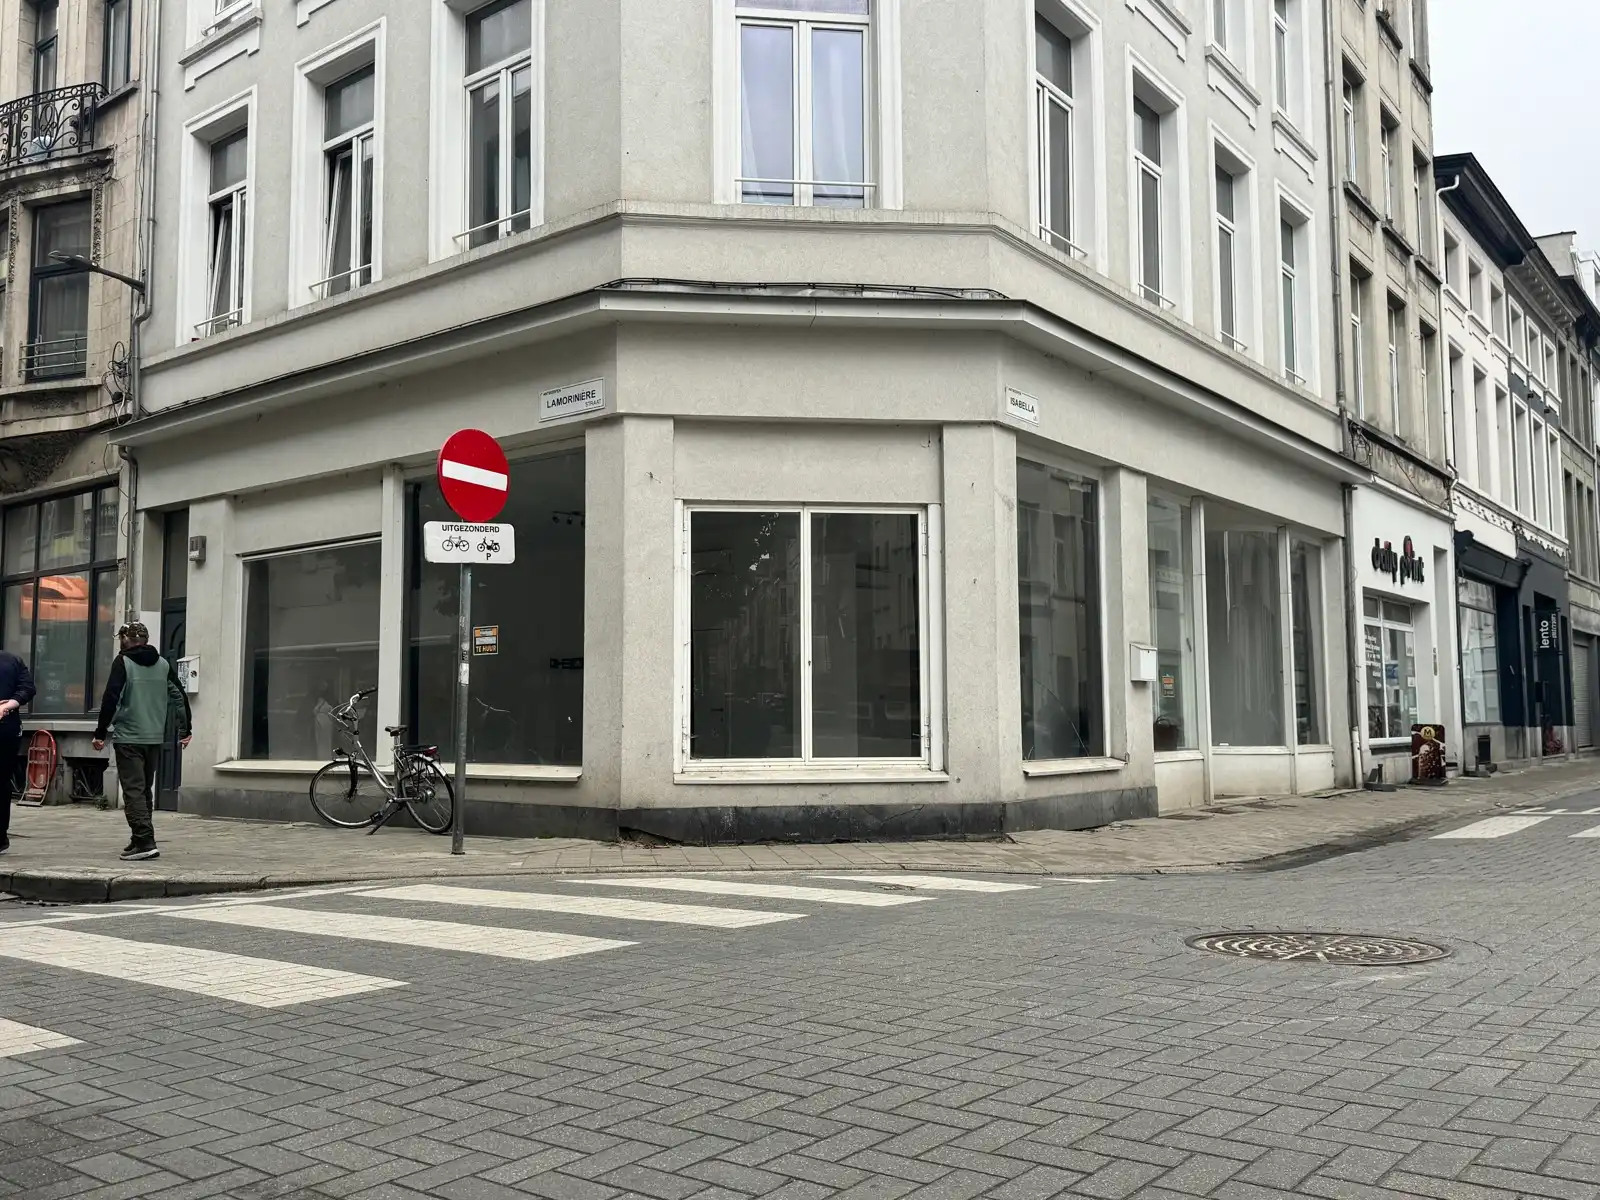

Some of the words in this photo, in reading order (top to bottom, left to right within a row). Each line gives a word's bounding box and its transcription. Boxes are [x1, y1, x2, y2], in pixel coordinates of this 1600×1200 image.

[546, 389, 597, 409] LAMORINIÈRE
[585, 399, 602, 408] STRAAT
[1010, 397, 1036, 414] ISABELLA
[441, 524, 500, 533] UITGEZONDERD
[486, 552, 492, 561] P
[1539, 620, 1550, 649] lento
[475, 645, 482, 653] TE
[482, 644, 497, 652] HUUR
